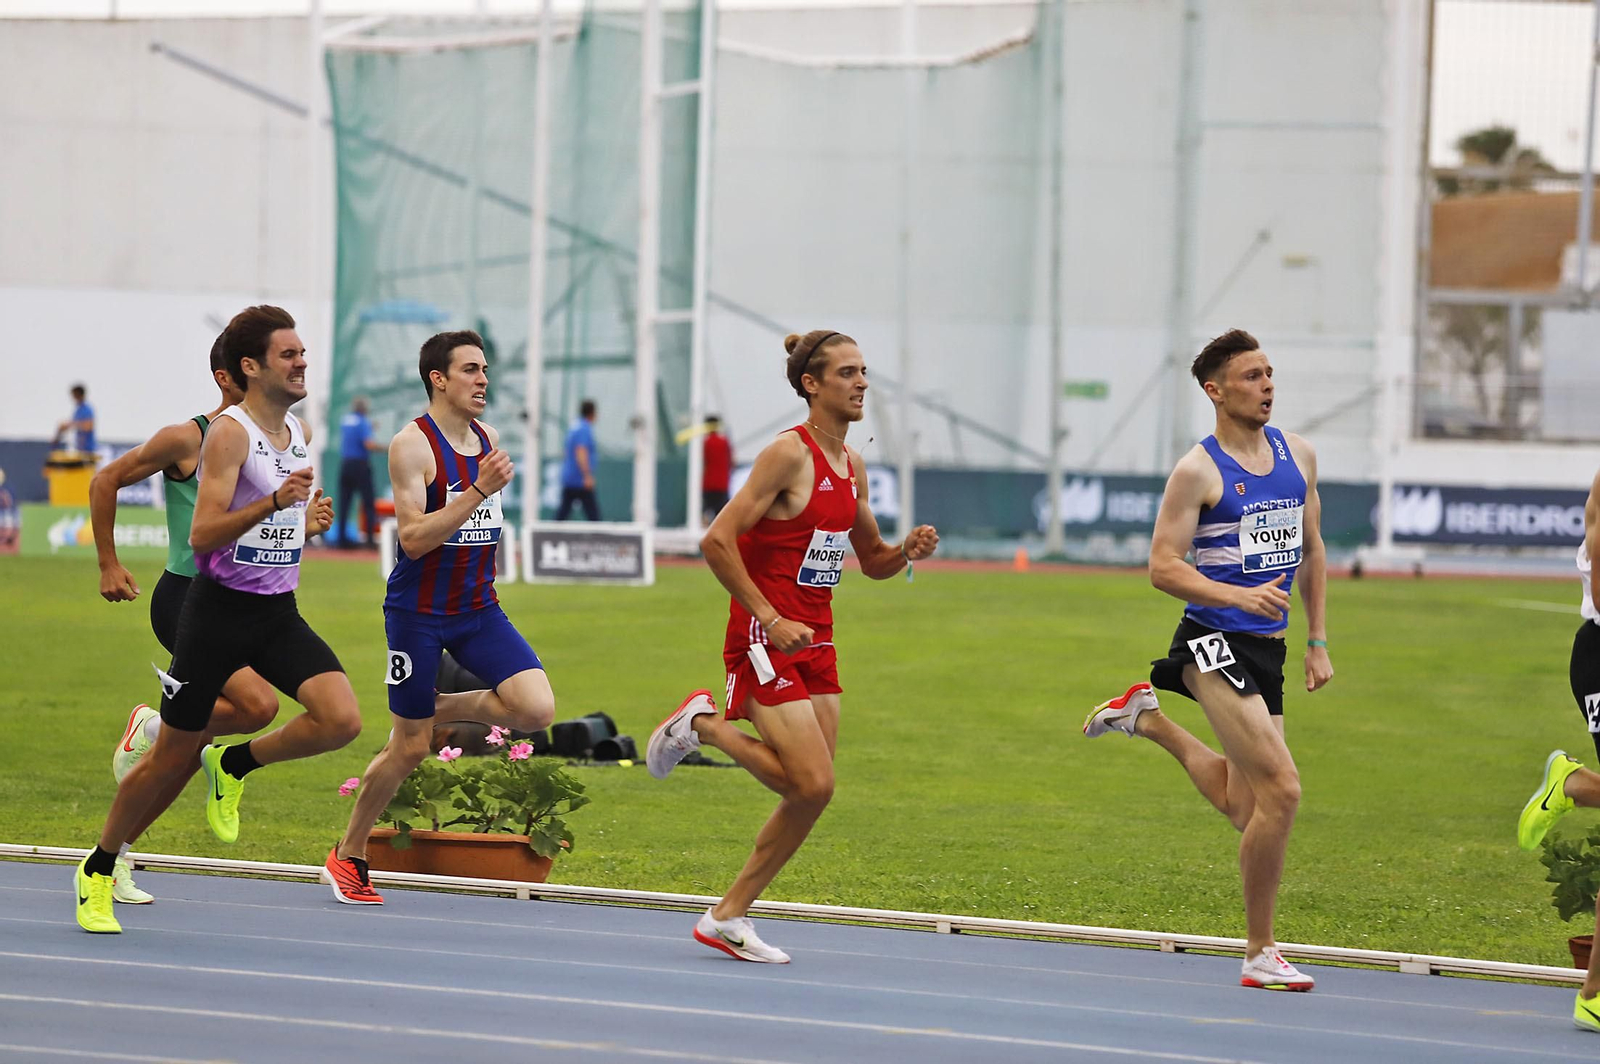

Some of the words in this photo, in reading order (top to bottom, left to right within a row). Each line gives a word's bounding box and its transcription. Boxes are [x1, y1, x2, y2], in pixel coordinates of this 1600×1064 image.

[1242, 498, 1299, 515] MORPETH
[470, 508, 492, 520] OYA
[472, 520, 481, 528] 31
[260, 528, 295, 540] SAEZ
[1249, 526, 1297, 544] YOUNG
[273, 541, 284, 549] 26
[1274, 541, 1286, 550] 19
[1195, 637, 1232, 667] 12
[391, 654, 406, 682] 8
